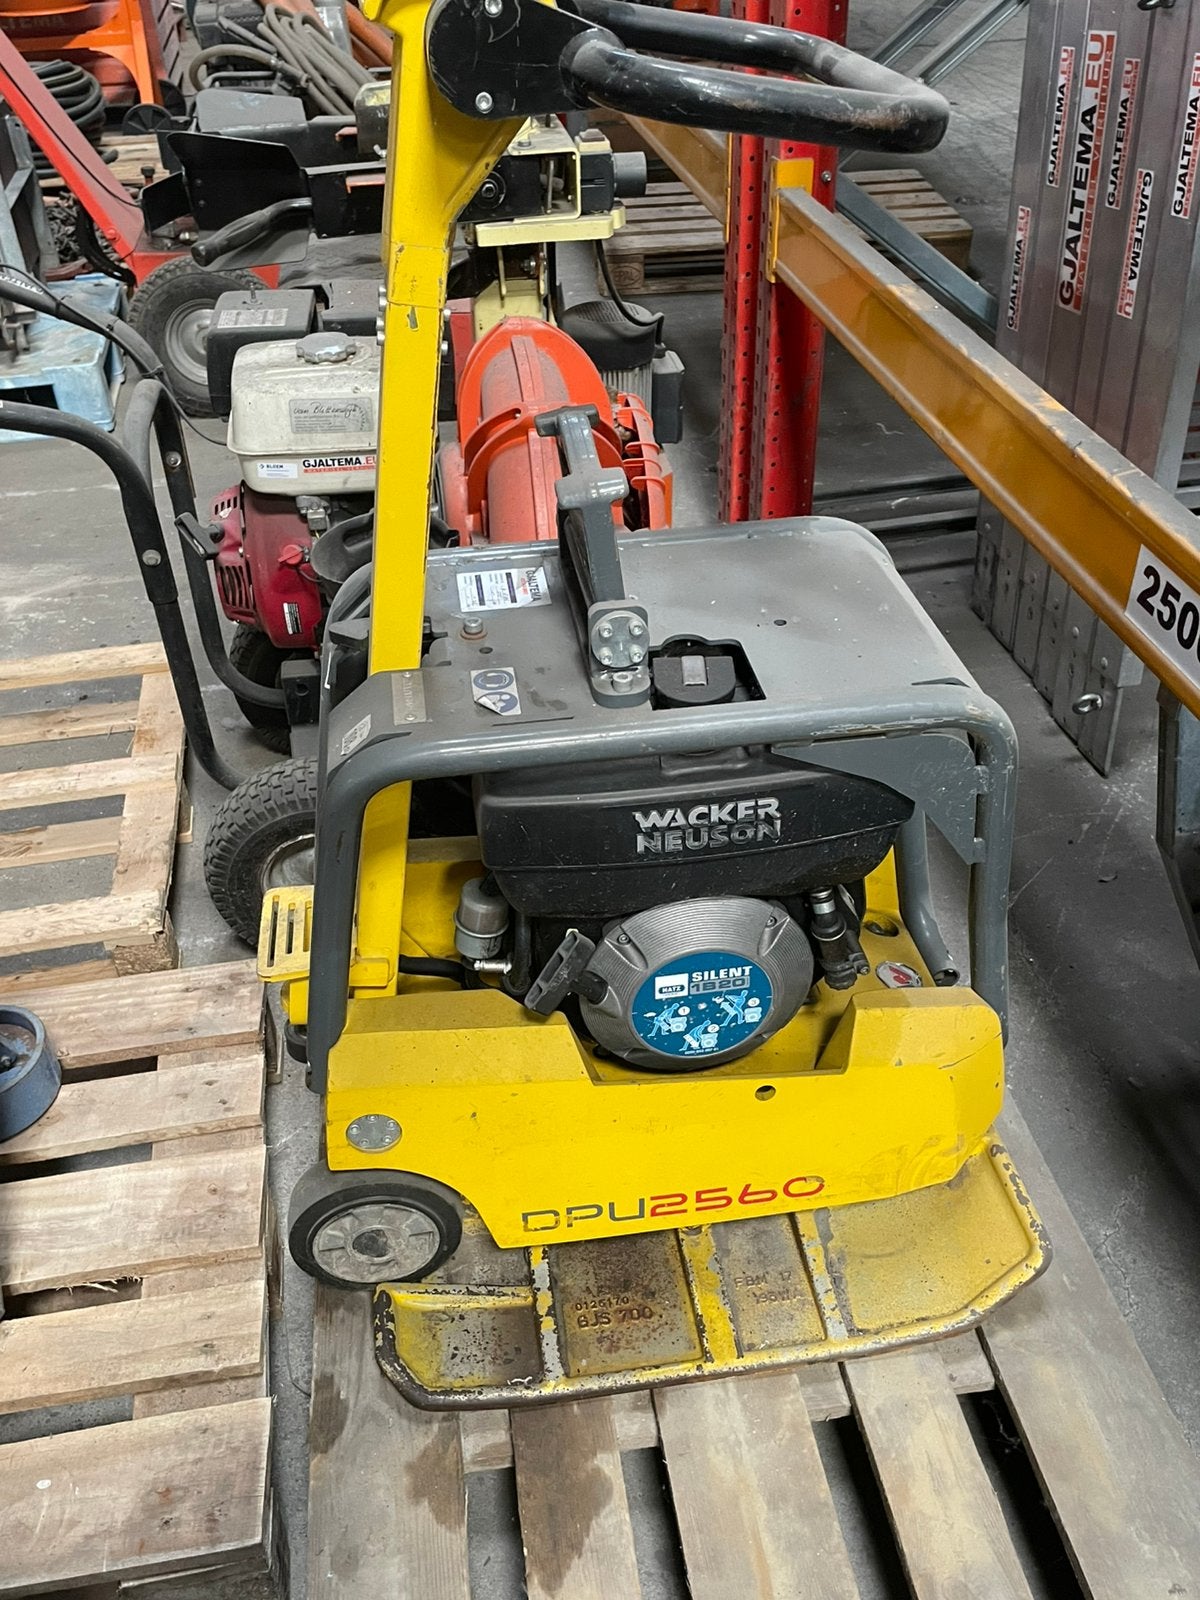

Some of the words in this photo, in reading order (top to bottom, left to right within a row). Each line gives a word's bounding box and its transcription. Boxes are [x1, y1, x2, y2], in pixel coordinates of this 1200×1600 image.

[1048, 49, 1073, 184] GJALTEMA.EU
[1092, 50, 1113, 160] VERHUUR
[1107, 60, 1134, 206] GJALTEMA.EU
[1059, 33, 1105, 306] GJALTEMA.EU
[1008, 207, 1027, 328] GJALTEMA.EU
[1123, 171, 1152, 317] GJALTEMA.EU
[1136, 564, 1200, 664] 250
[632, 797, 782, 831] WACKER
[636, 818, 782, 854] NEUSON
[691, 977, 746, 993] 1B20
[692, 965, 752, 982] SILENT
[521, 1175, 826, 1233] DPU2560
